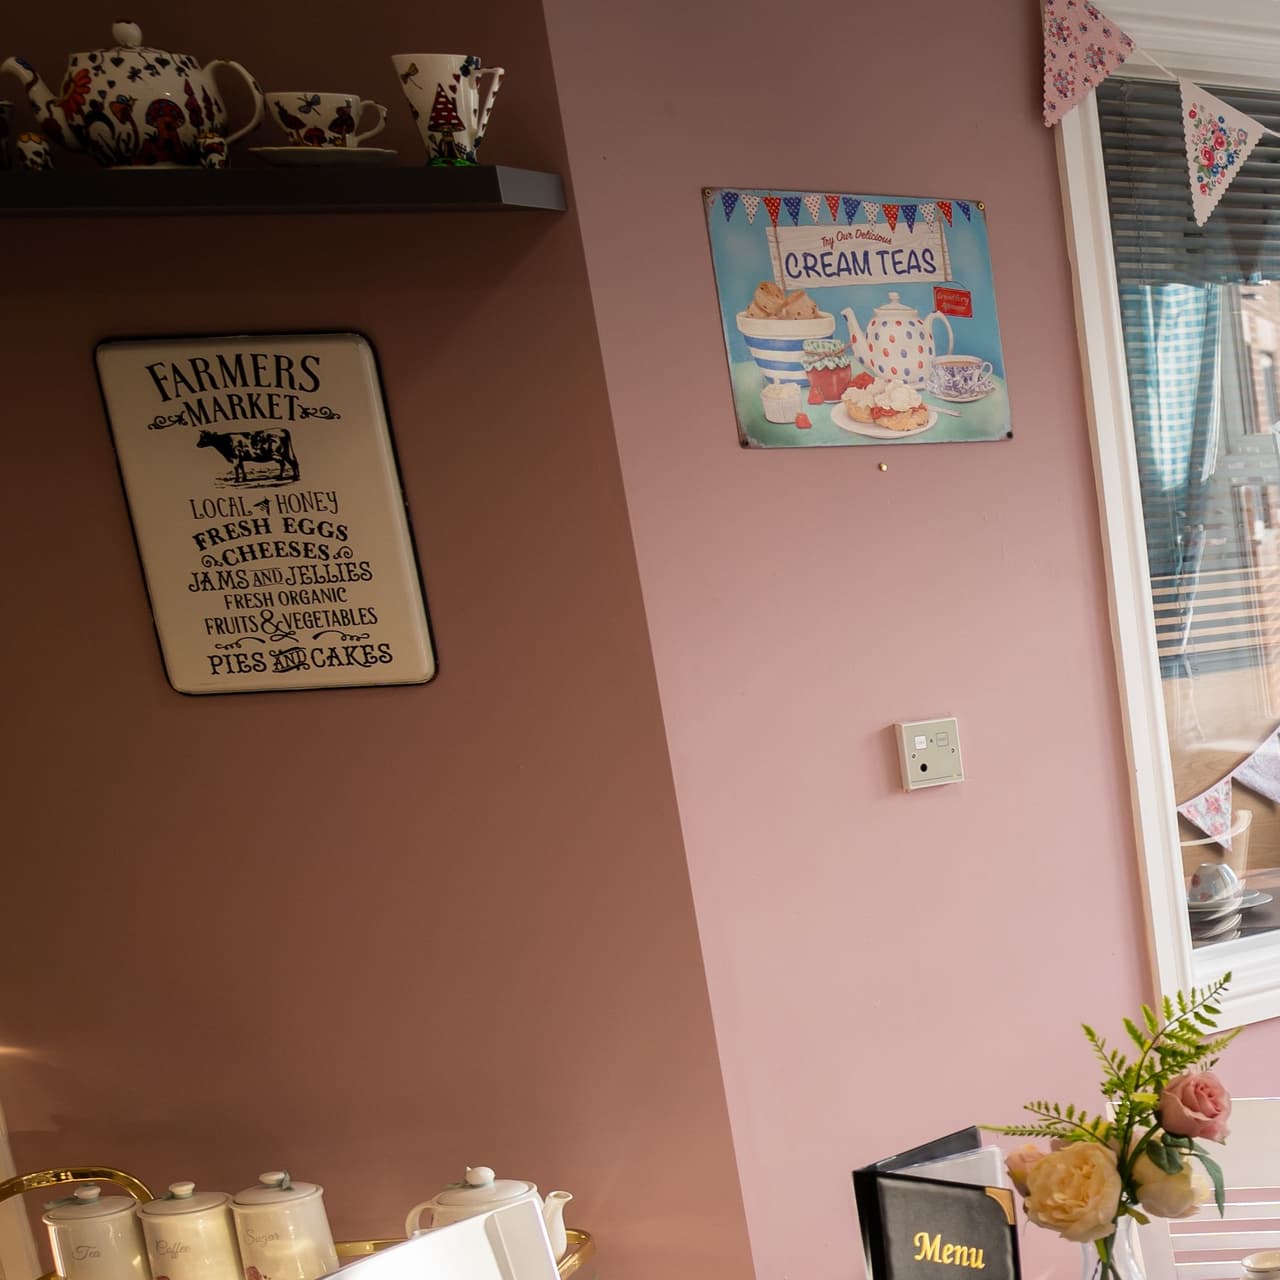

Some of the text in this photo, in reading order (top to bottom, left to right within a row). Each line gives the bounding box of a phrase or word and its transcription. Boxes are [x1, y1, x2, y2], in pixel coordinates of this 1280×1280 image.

[820, 229, 892, 250] Try Our Delicious
[785, 247, 937, 279] CREAM TEAS
[145, 353, 321, 402] FARMERS
[183, 392, 299, 427] MARKET
[189, 491, 338, 519] LOCAL HONEY
[192, 516, 348, 551] FRESH EGGS
[222, 540, 330, 567] CHEESES
[188, 561, 373, 592] JAMS AND JELLIES
[223, 586, 348, 610] FRESH ORGANIC
[204, 614, 259, 635] FRUITS
[282, 607, 378, 630] VEGETABLES
[207, 643, 393, 675] PIES AND CAKES
[72, 1245, 100, 1261] Tea
[155, 1240, 191, 1260] Coffee
[246, 1230, 280, 1248] Sugar
[912, 1231, 986, 1270] Menu
